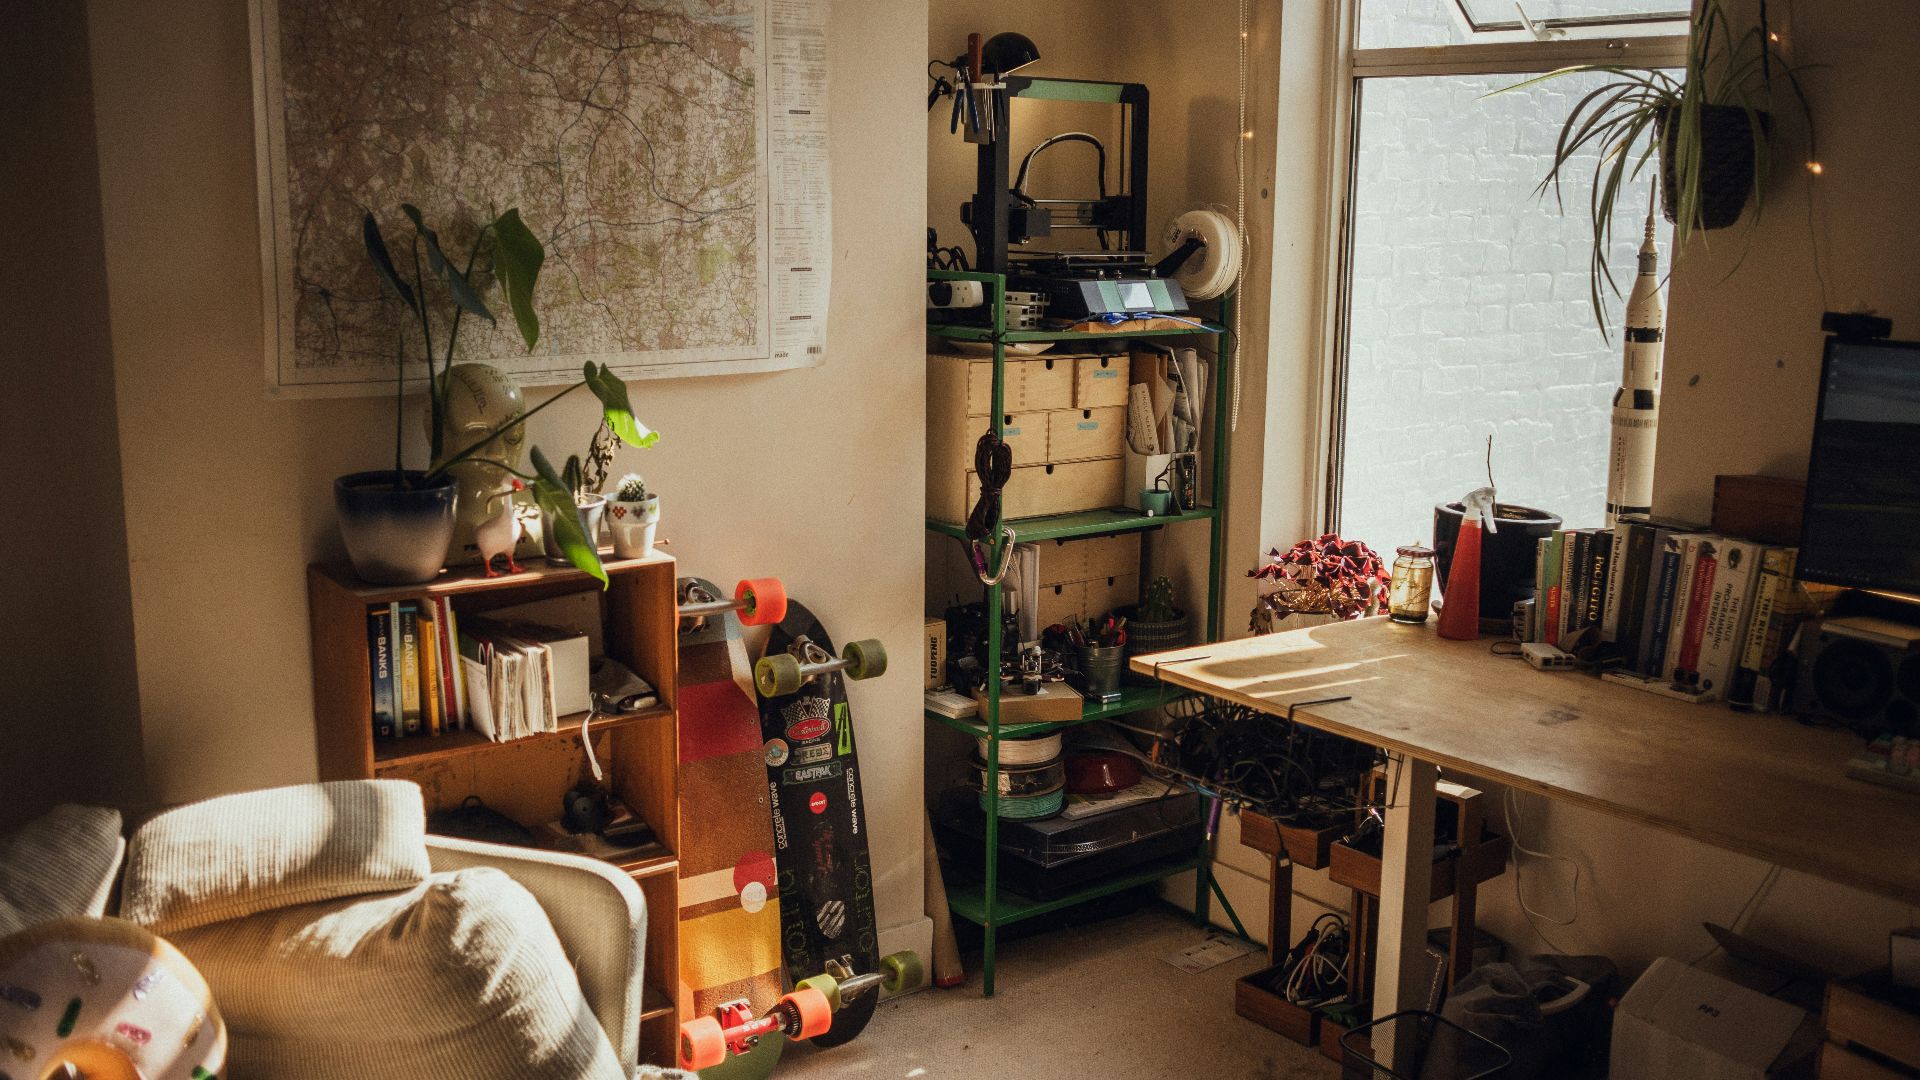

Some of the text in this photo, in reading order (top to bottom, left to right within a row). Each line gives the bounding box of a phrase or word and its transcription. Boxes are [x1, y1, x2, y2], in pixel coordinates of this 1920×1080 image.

[1610, 552, 1620, 592] Hardware
[1707, 591, 1721, 636] INTERFACE
[1713, 583, 1732, 649] PROGRAMMING
[1724, 597, 1739, 641] THE LINUX
[1755, 598, 1770, 646] THE RUST
[377, 636, 387, 678] BANKS
[403, 634, 414, 676] BANKS
[769, 781, 780, 808] wave
[848, 767, 858, 808] concrete
[772, 808, 785, 850] concrete
